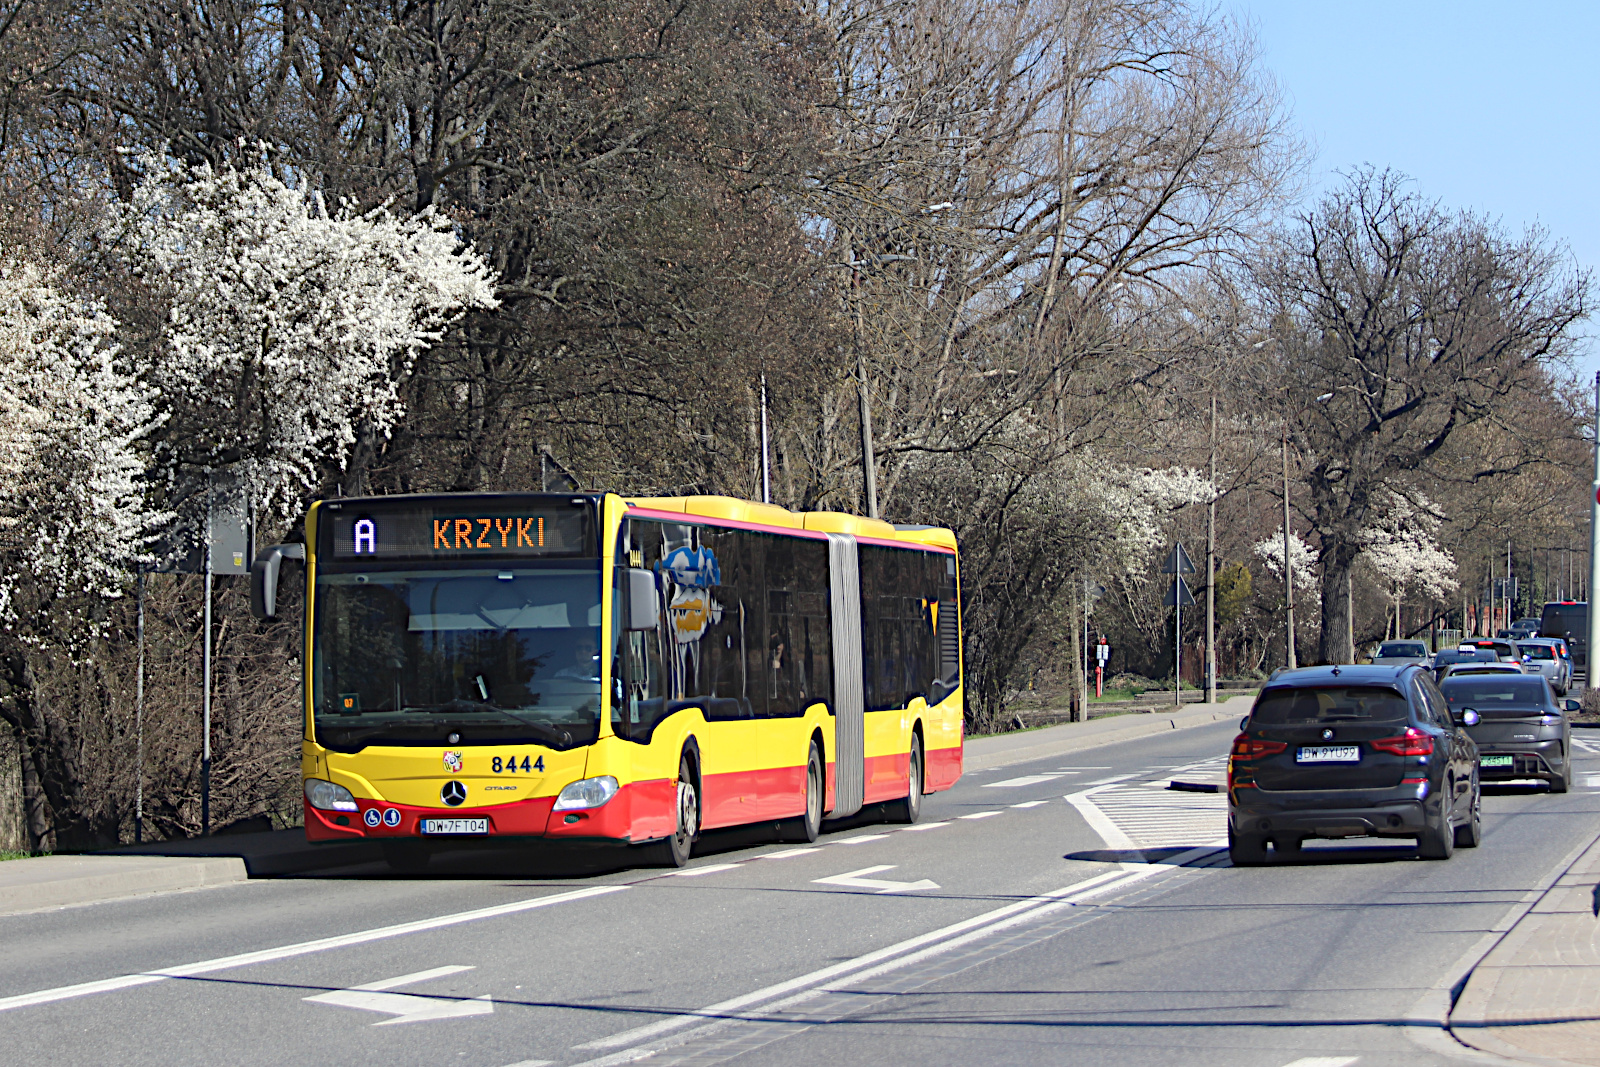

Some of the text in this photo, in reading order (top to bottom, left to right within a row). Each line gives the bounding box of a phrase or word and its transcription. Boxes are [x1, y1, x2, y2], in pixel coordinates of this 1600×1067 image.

[355, 519, 375, 553] A
[433, 517, 544, 549] KRZYKI
[1304, 748, 1318, 758] DW
[491, 755, 545, 773] 8444
[429, 820, 485, 832] DW 7FT04
